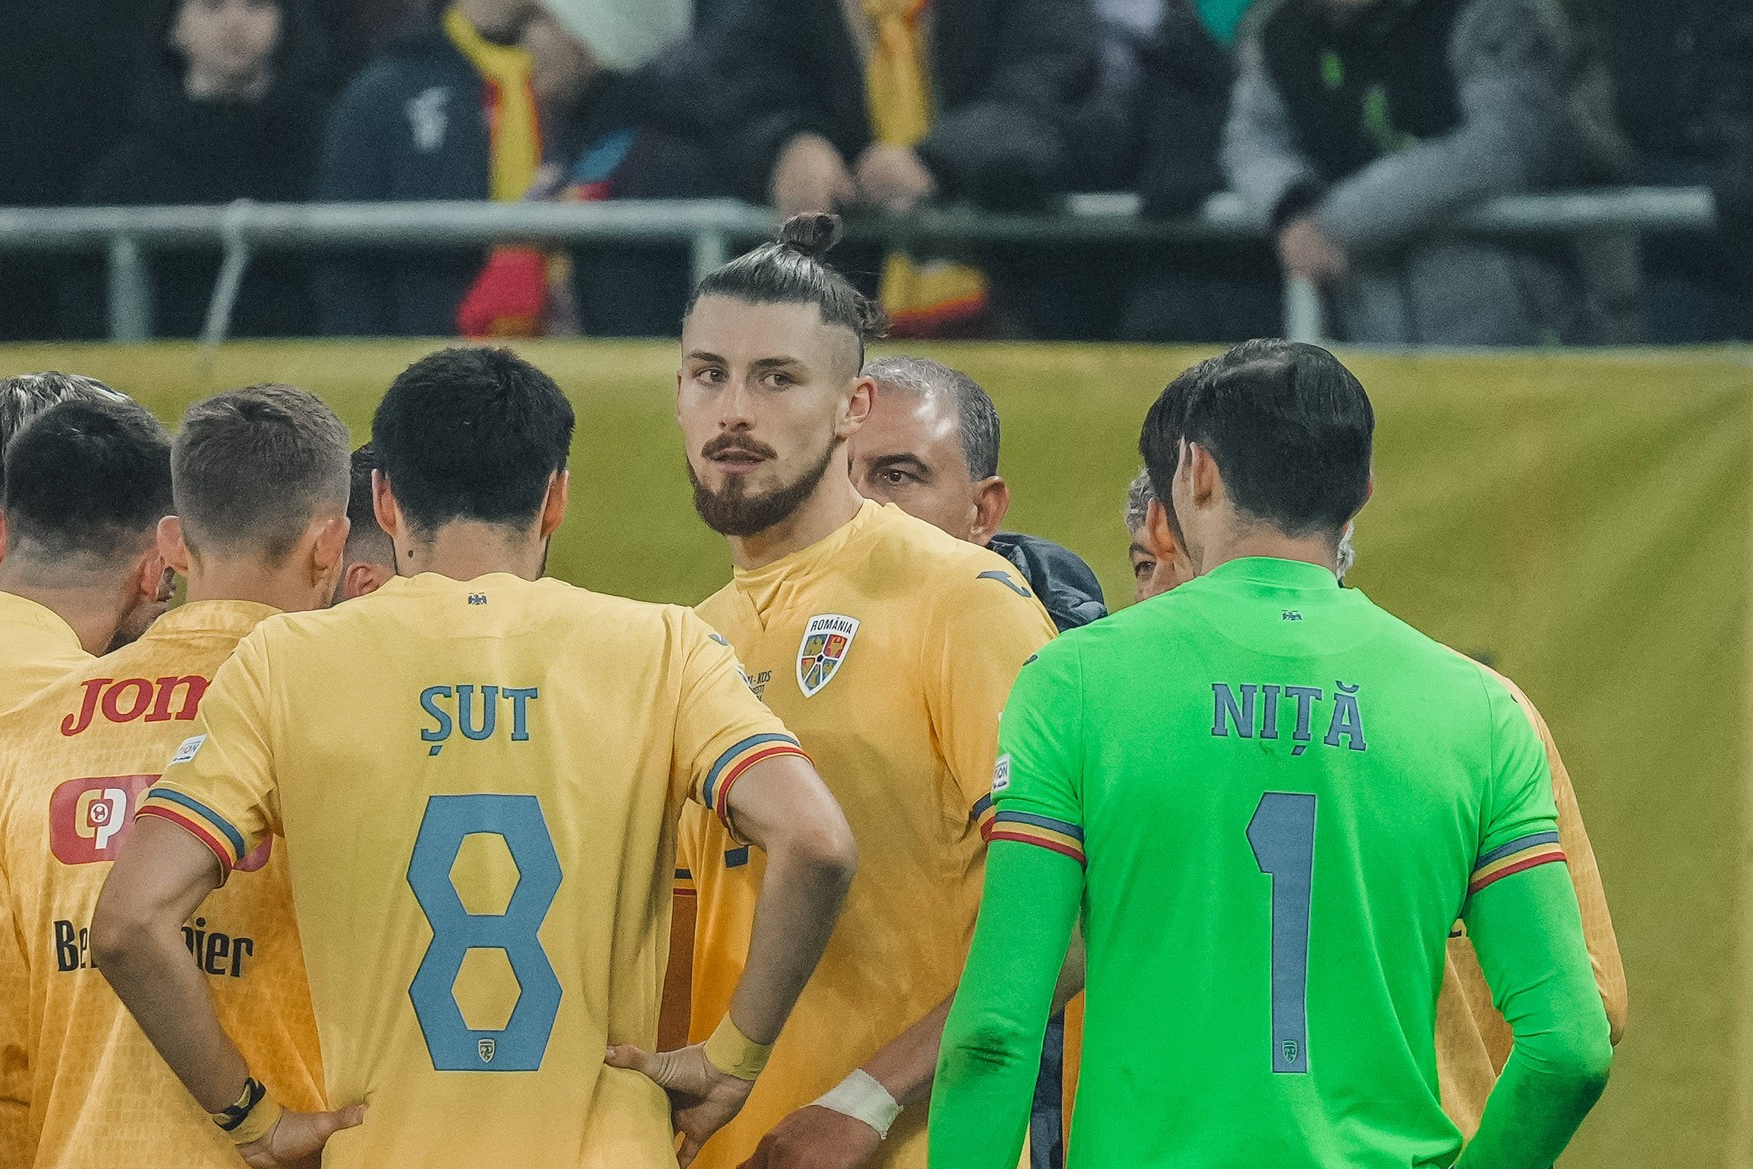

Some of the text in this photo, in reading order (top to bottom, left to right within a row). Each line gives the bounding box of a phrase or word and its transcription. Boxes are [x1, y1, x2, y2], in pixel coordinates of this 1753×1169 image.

[810, 616, 853, 635] ROMÂNIA
[419, 684, 539, 757] ȘUT
[1210, 680, 1367, 757] NIȚĂ
[406, 794, 563, 1072] 8
[1245, 791, 1317, 1074] 1
